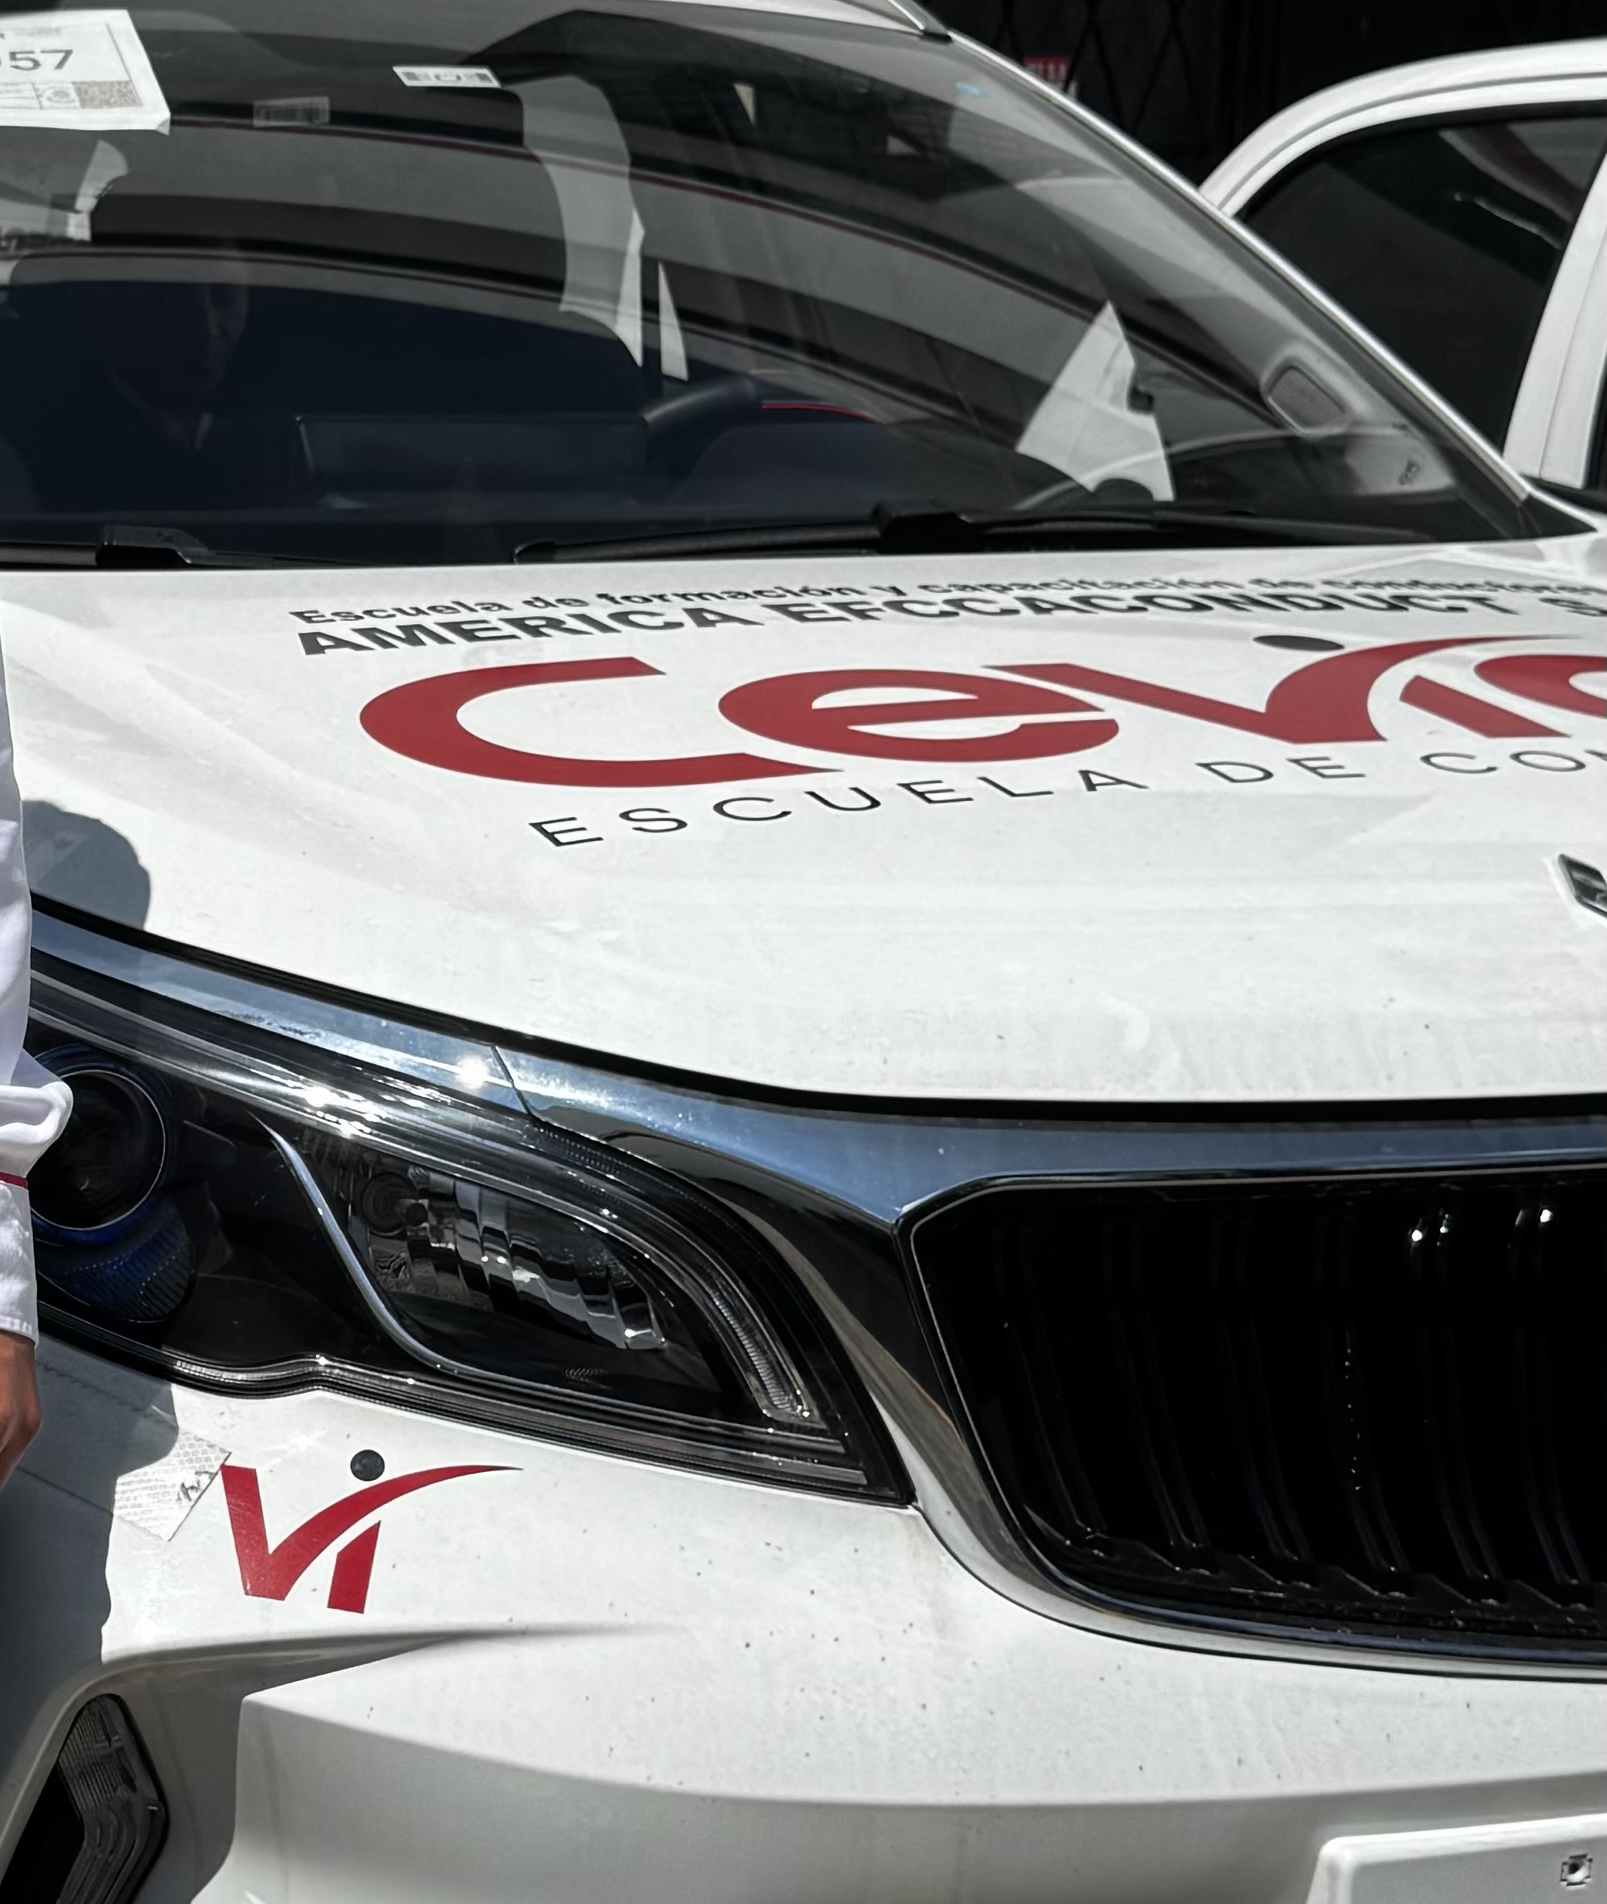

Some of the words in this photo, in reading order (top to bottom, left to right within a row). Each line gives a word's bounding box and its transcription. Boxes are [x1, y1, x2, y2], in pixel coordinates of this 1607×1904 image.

[289, 600, 514, 624] Escuela
[521, 596, 590, 609] de
[595, 586, 867, 605] formación
[869, 585, 908, 597] y
[297, 606, 766, 656] AMERICA
[760, 594, 1520, 624] EFCCACONDUCT
[528, 766, 1150, 848] ESCUELA
[1195, 756, 1366, 783] DE
